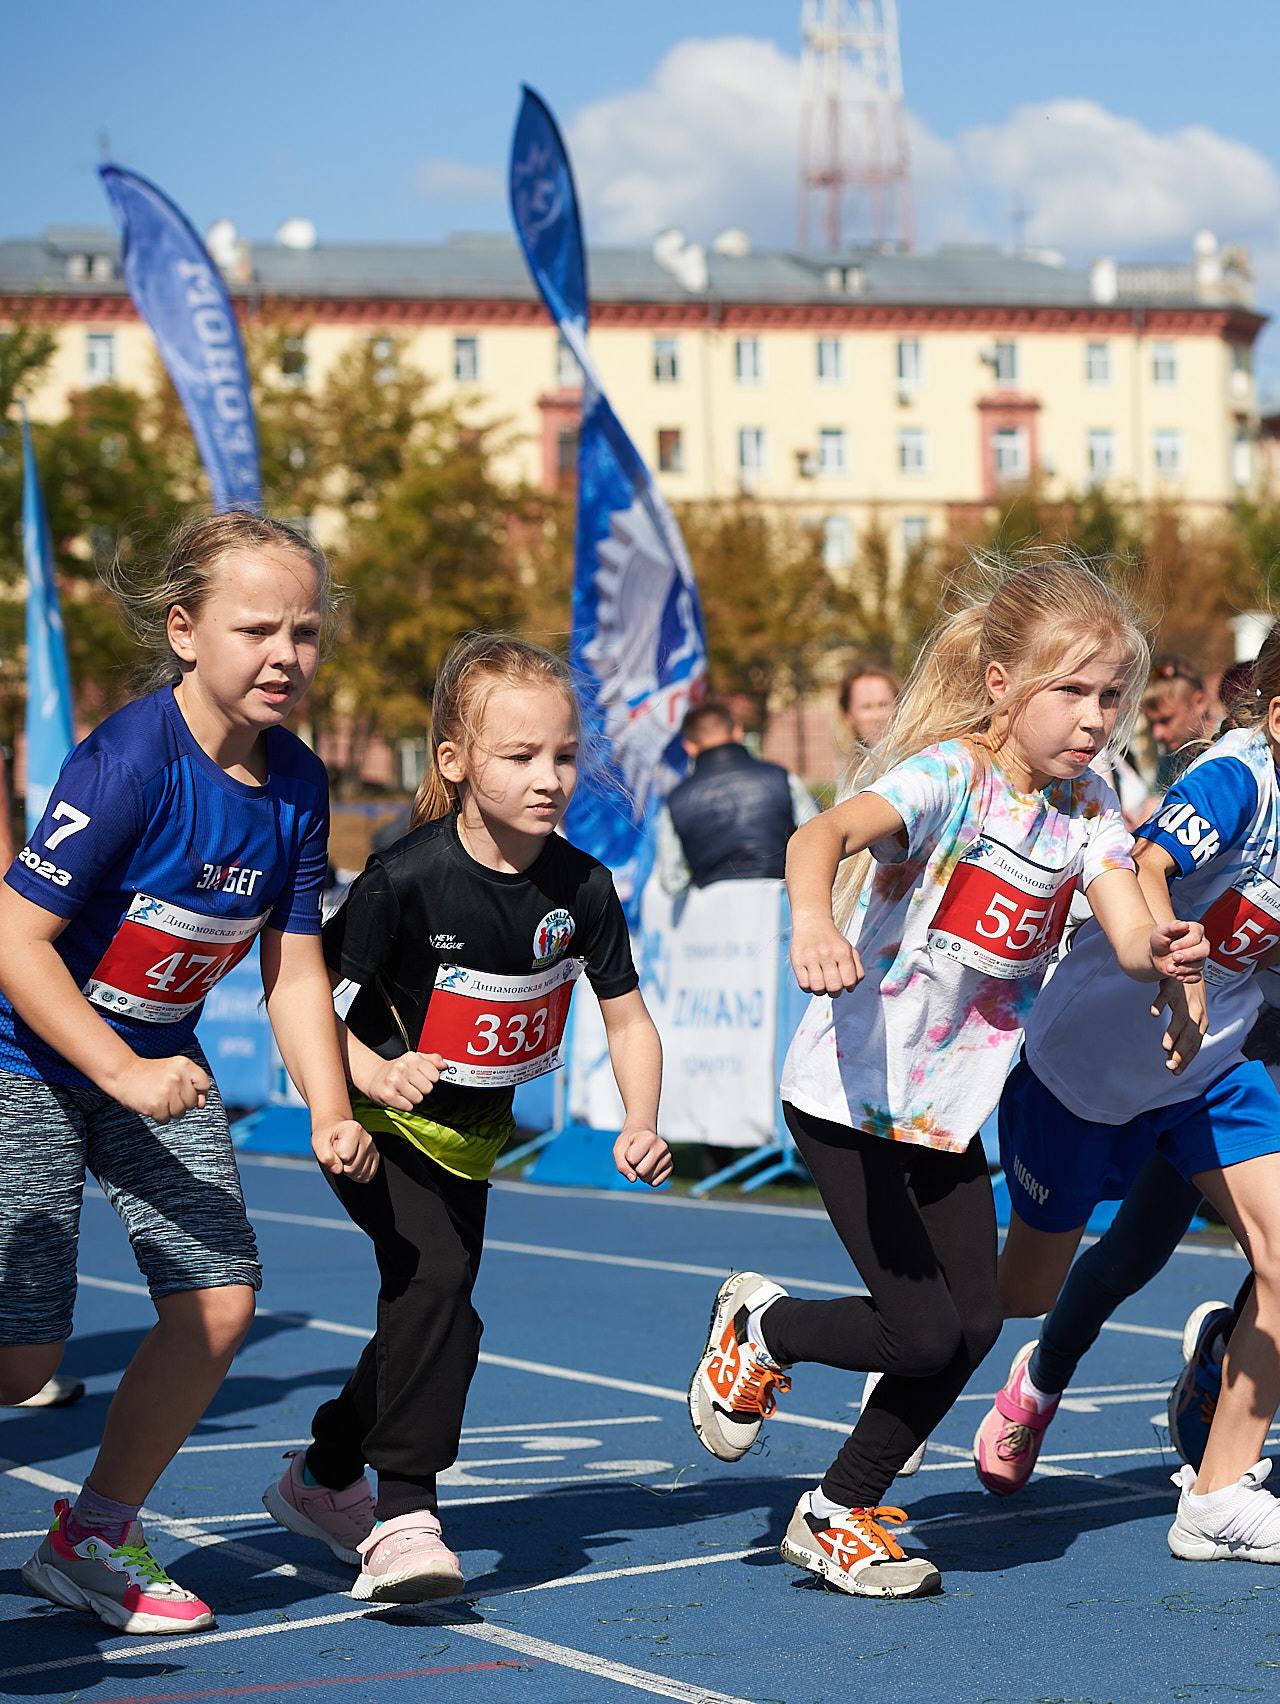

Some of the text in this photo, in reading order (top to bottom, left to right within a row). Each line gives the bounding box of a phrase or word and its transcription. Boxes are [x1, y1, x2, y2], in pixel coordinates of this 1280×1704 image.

[43, 800, 92, 851] 7
[18, 846, 73, 887] 2023
[162, 913, 236, 938] Динамовская
[434, 934, 457, 942] NEW
[144, 951, 235, 994] 474
[470, 980, 542, 995] Динамовская
[467, 1007, 548, 1057] 333
[1013, 1154, 1050, 1206] HUSKY
